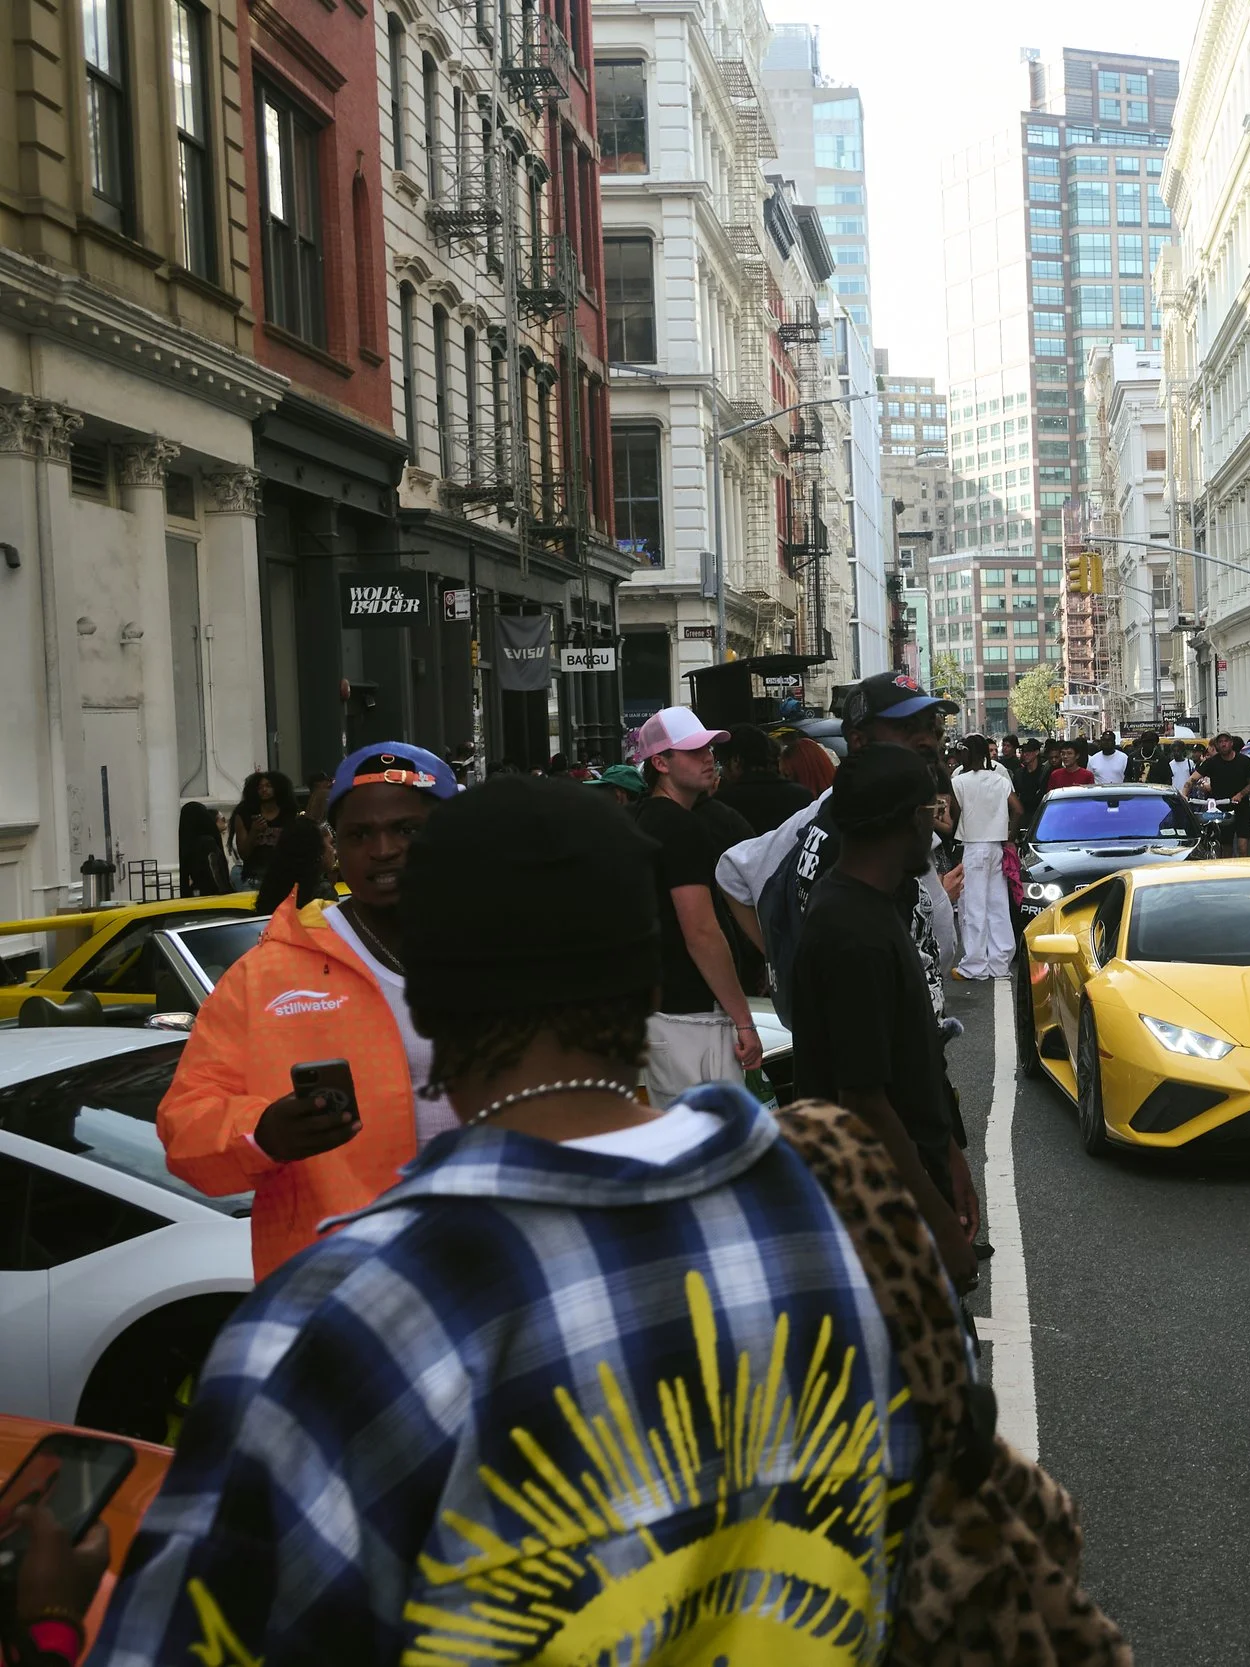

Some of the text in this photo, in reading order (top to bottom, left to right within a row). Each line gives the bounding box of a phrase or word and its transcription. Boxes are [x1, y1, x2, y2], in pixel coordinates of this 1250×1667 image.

[350, 599, 420, 614] BADGER
[685, 629, 713, 638] Greene St
[503, 647, 545, 659] EVISU
[275, 999, 343, 1015] stillwater
